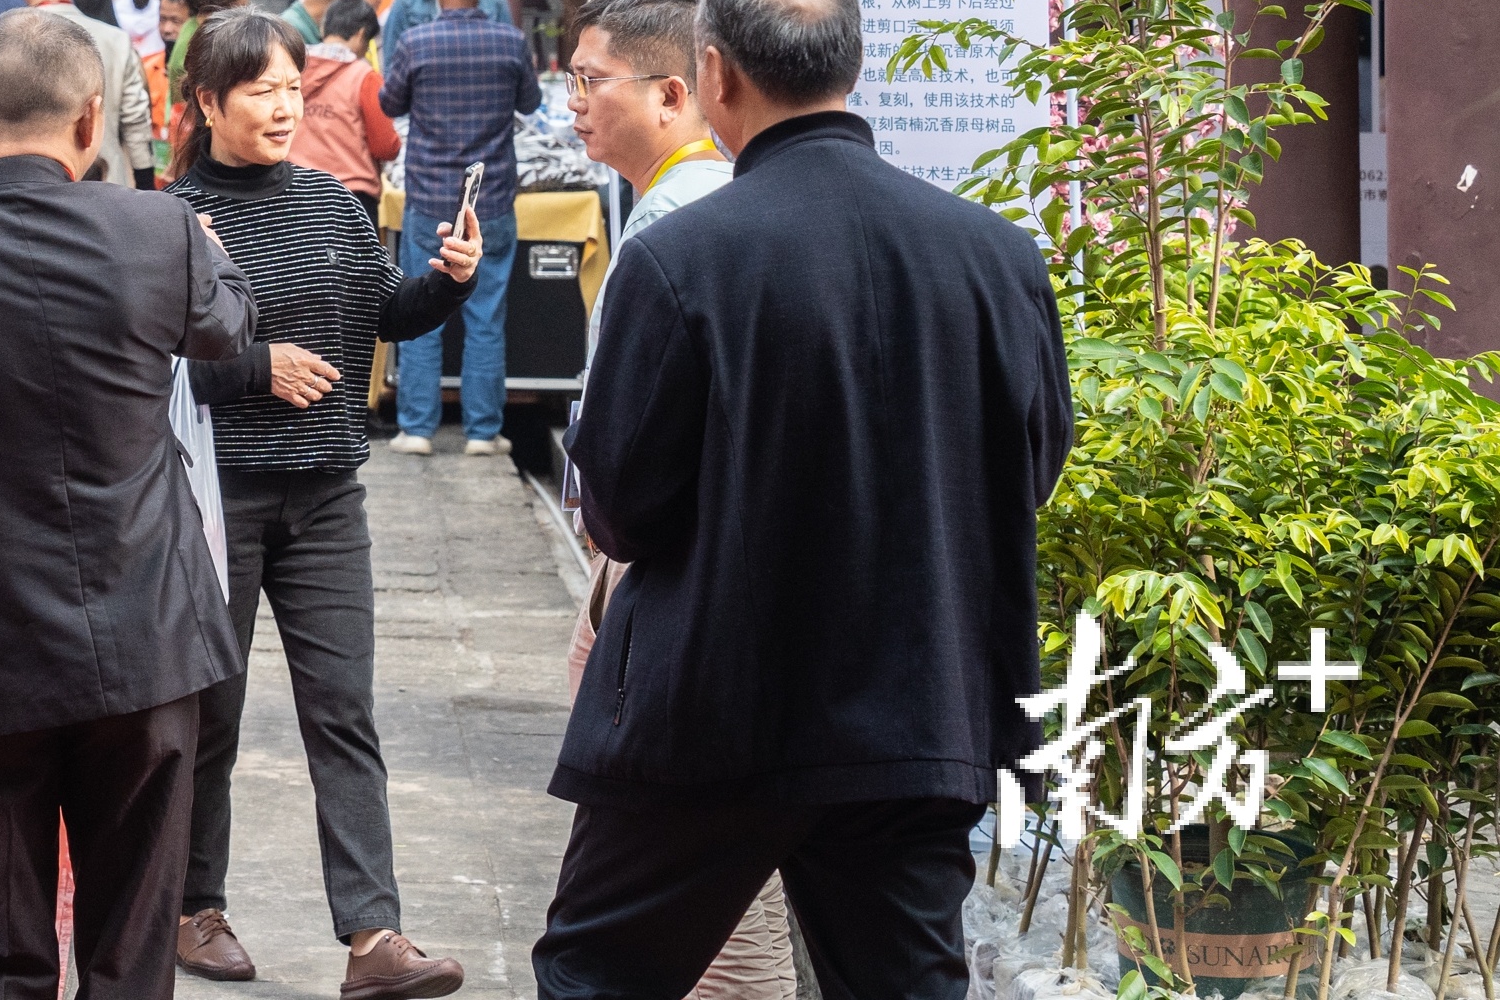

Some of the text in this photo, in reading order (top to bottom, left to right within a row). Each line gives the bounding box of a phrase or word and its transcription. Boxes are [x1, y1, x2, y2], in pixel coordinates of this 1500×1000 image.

[858, 67, 1015, 84] 也就是高压技术，也可
